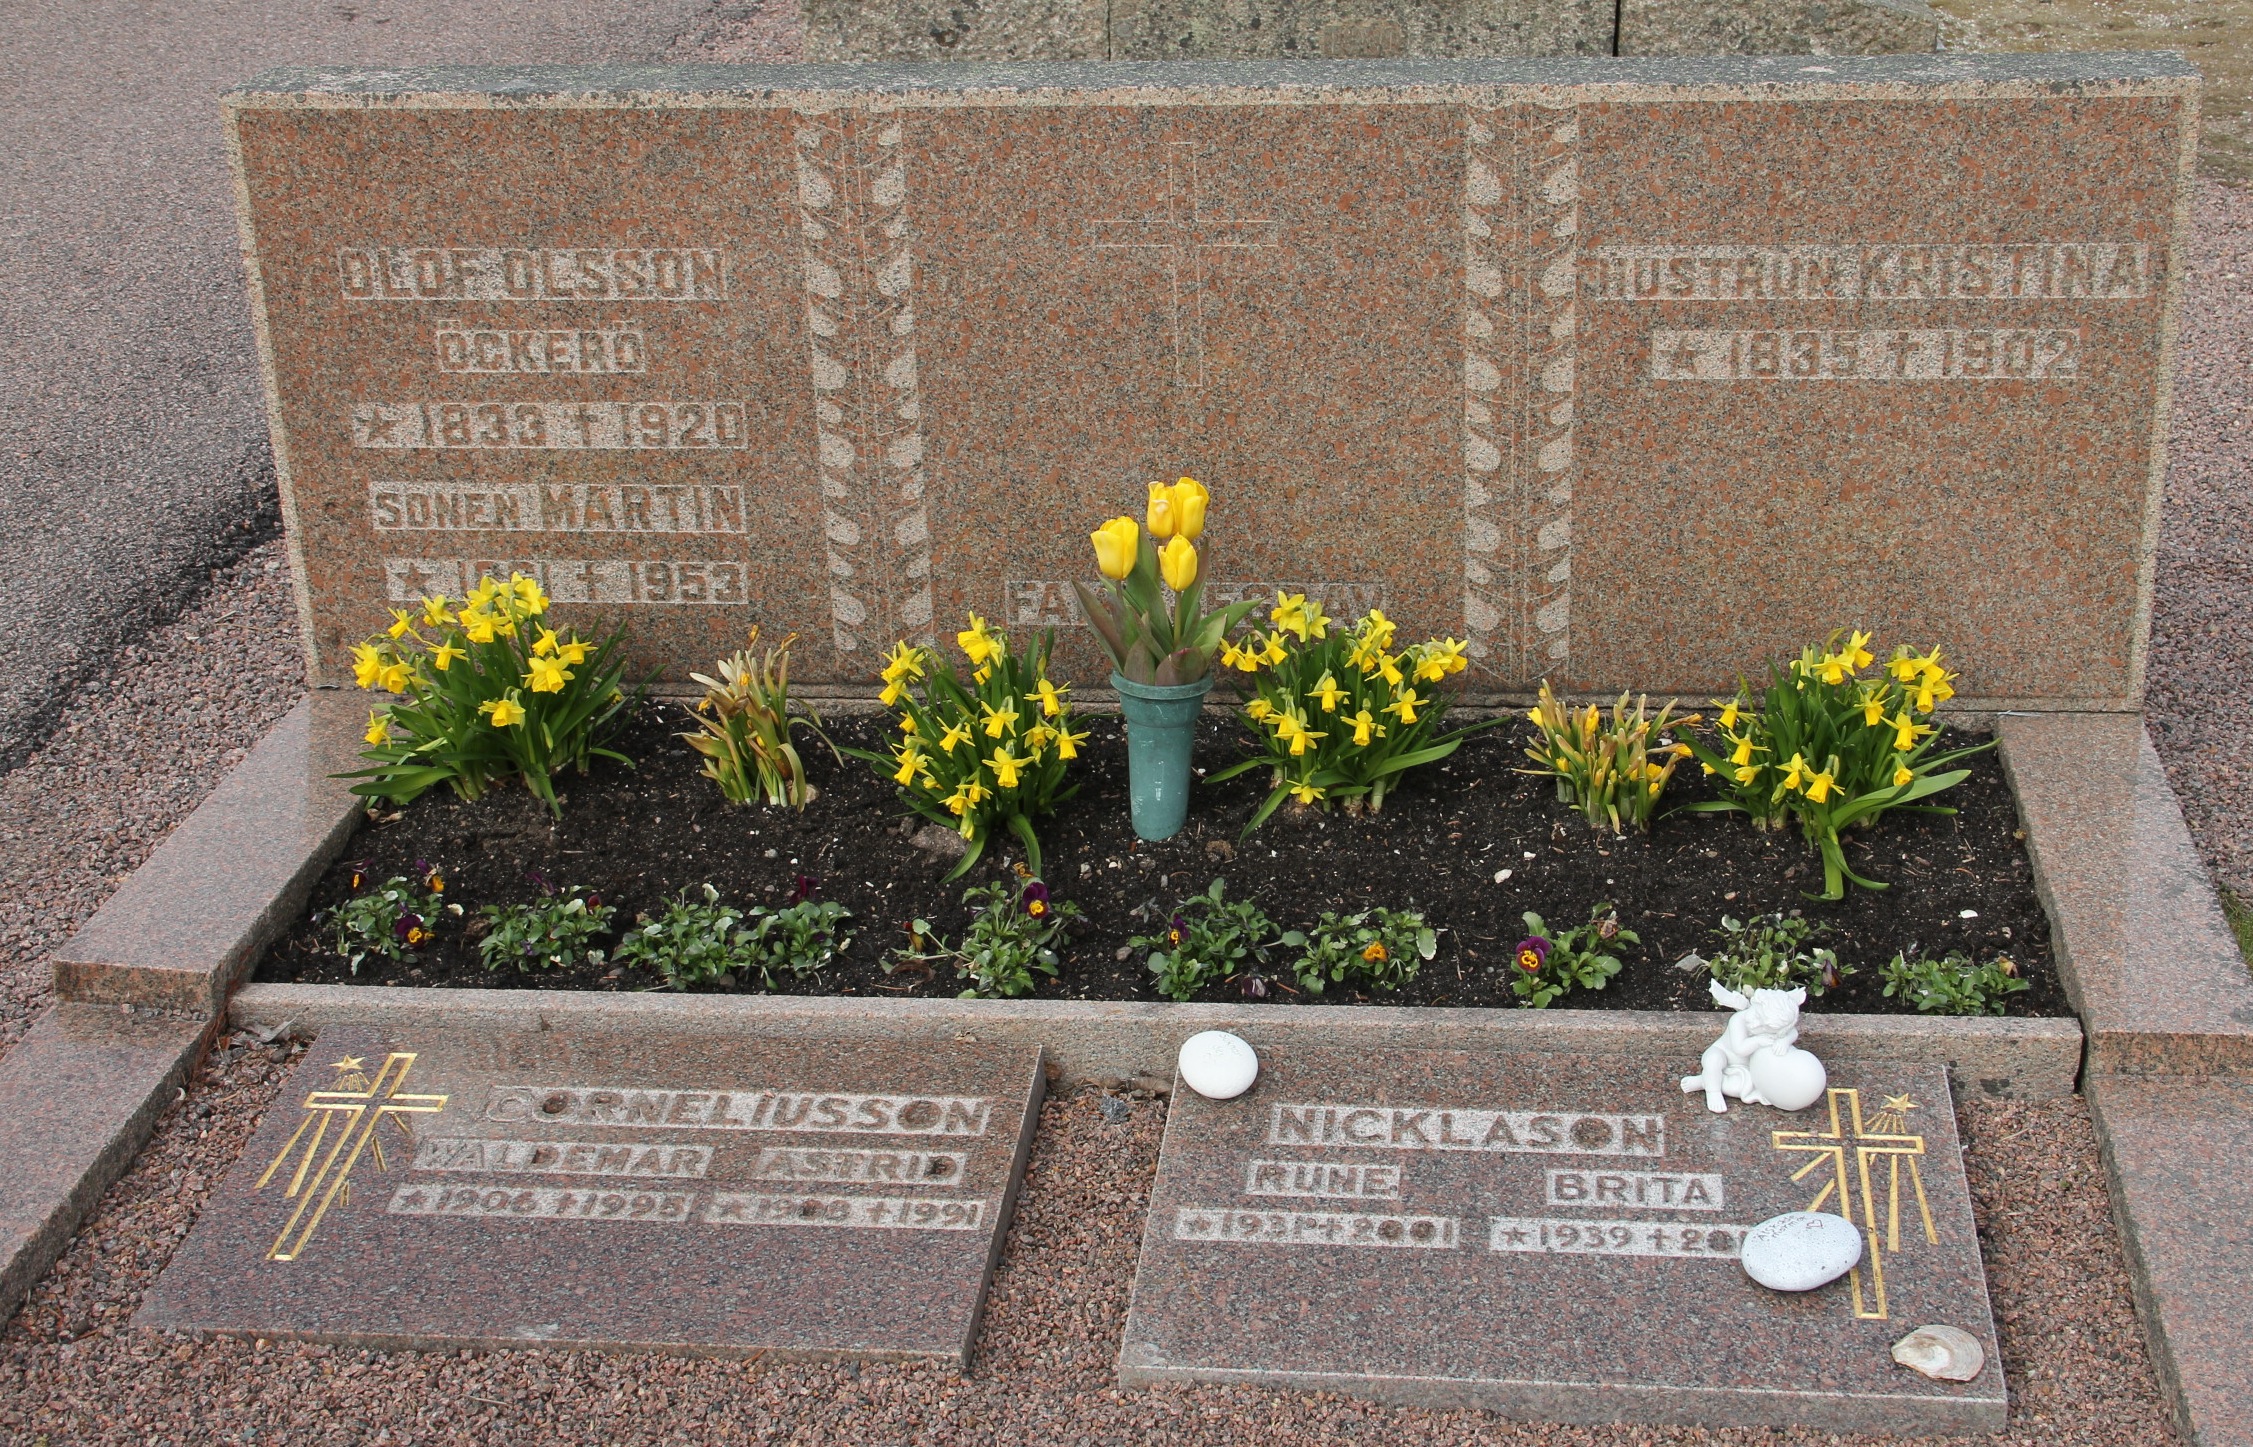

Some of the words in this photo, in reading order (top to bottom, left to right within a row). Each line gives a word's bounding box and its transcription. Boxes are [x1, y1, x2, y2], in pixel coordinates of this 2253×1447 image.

[340, 249, 474, 299] OLOF
[500, 249, 726, 299] OLSSON
[1858, 243, 2150, 298] KRISTINA
[1943, 330, 2076, 379] 1902
[421, 401, 548, 447] 1833
[619, 401, 747, 447] 1920
[374, 489, 525, 530] SONEN
[539, 485, 746, 532] MARTIN
[628, 561, 744, 603] 1953
[484, 1086, 990, 1136] CORNELIUSSON
[1276, 1106, 1664, 1155] NICKLASON
[414, 1140, 709, 1177] WALDEMAR
[762, 1151, 958, 1182] ASTRID
[436, 1189, 537, 1214] 1906
[1554, 1172, 1723, 1205] BRITA
[903, 1200, 980, 1226] 1991
[1539, 1223, 1633, 1249] 1939
